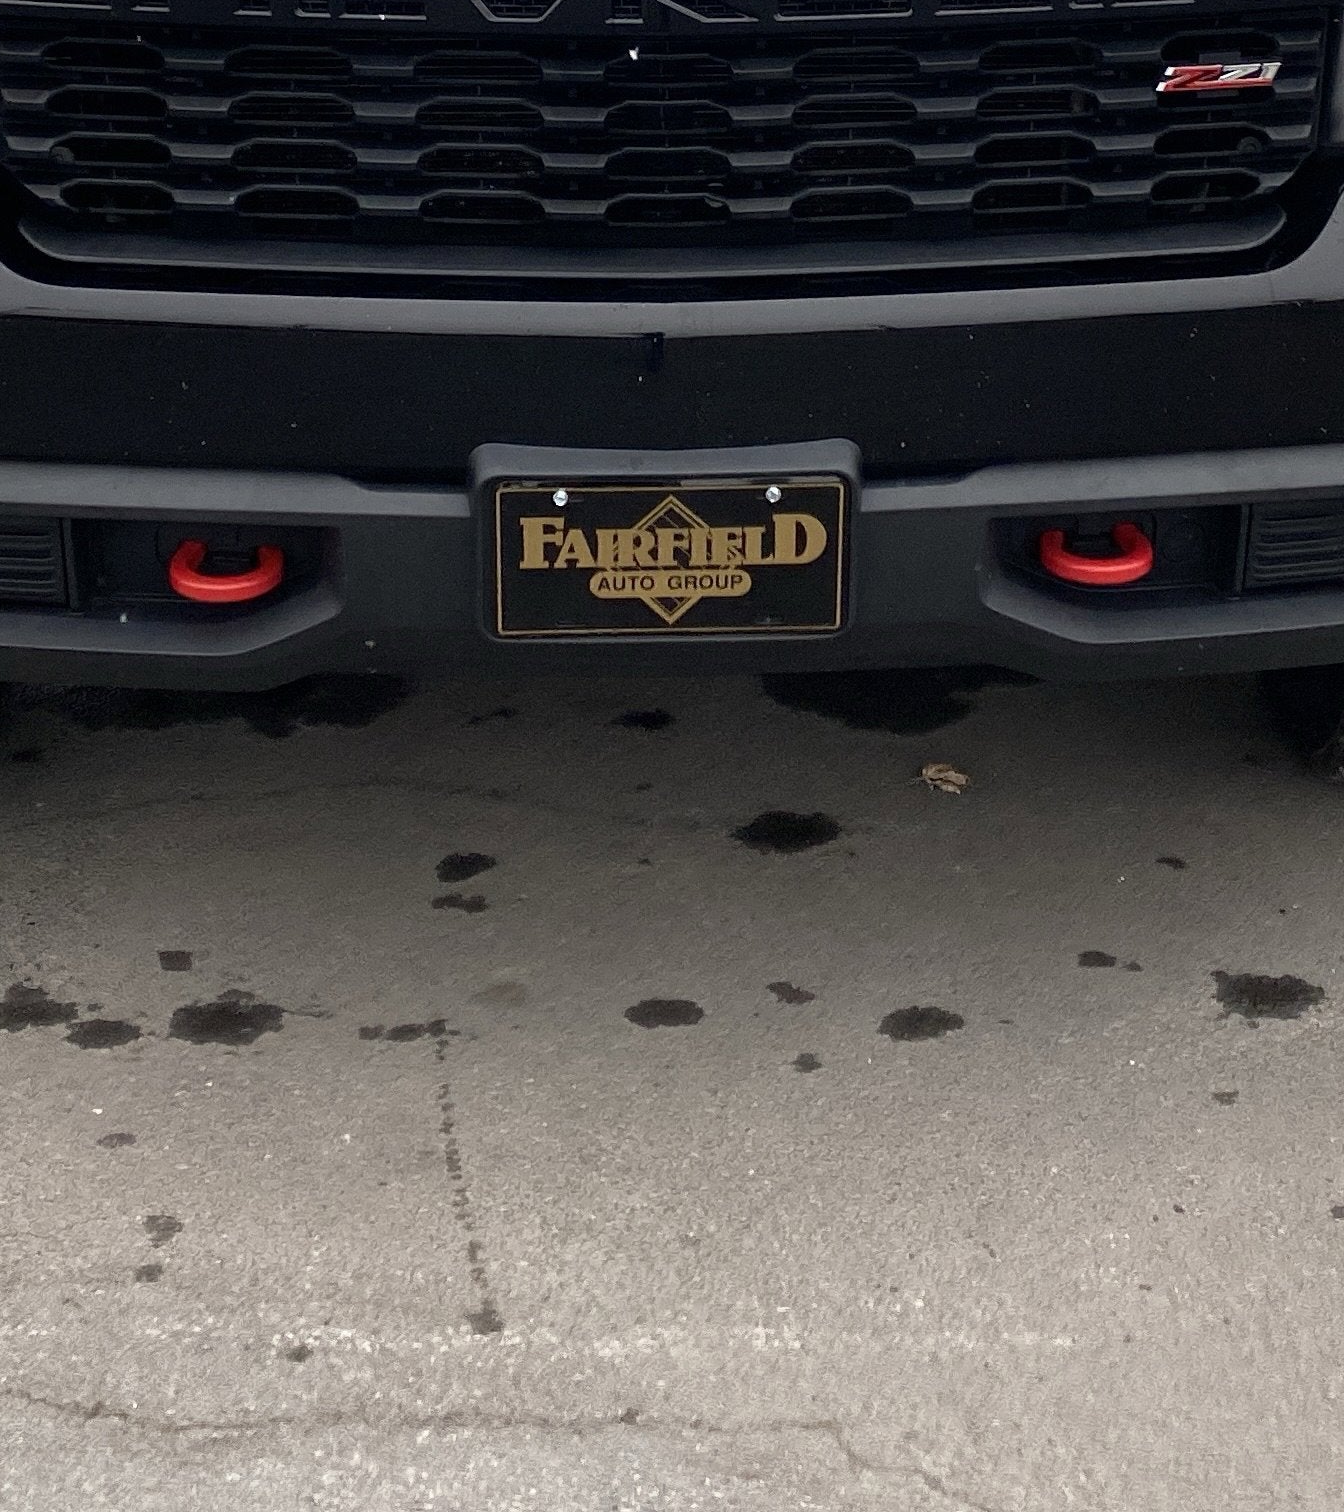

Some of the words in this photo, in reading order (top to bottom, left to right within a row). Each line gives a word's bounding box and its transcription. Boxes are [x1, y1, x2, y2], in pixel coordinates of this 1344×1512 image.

[1156, 62, 1282, 92] Z71
[519, 513, 828, 570] FAIRFIELD
[597, 575, 655, 591] AUTO
[667, 574, 744, 590] GROUP
